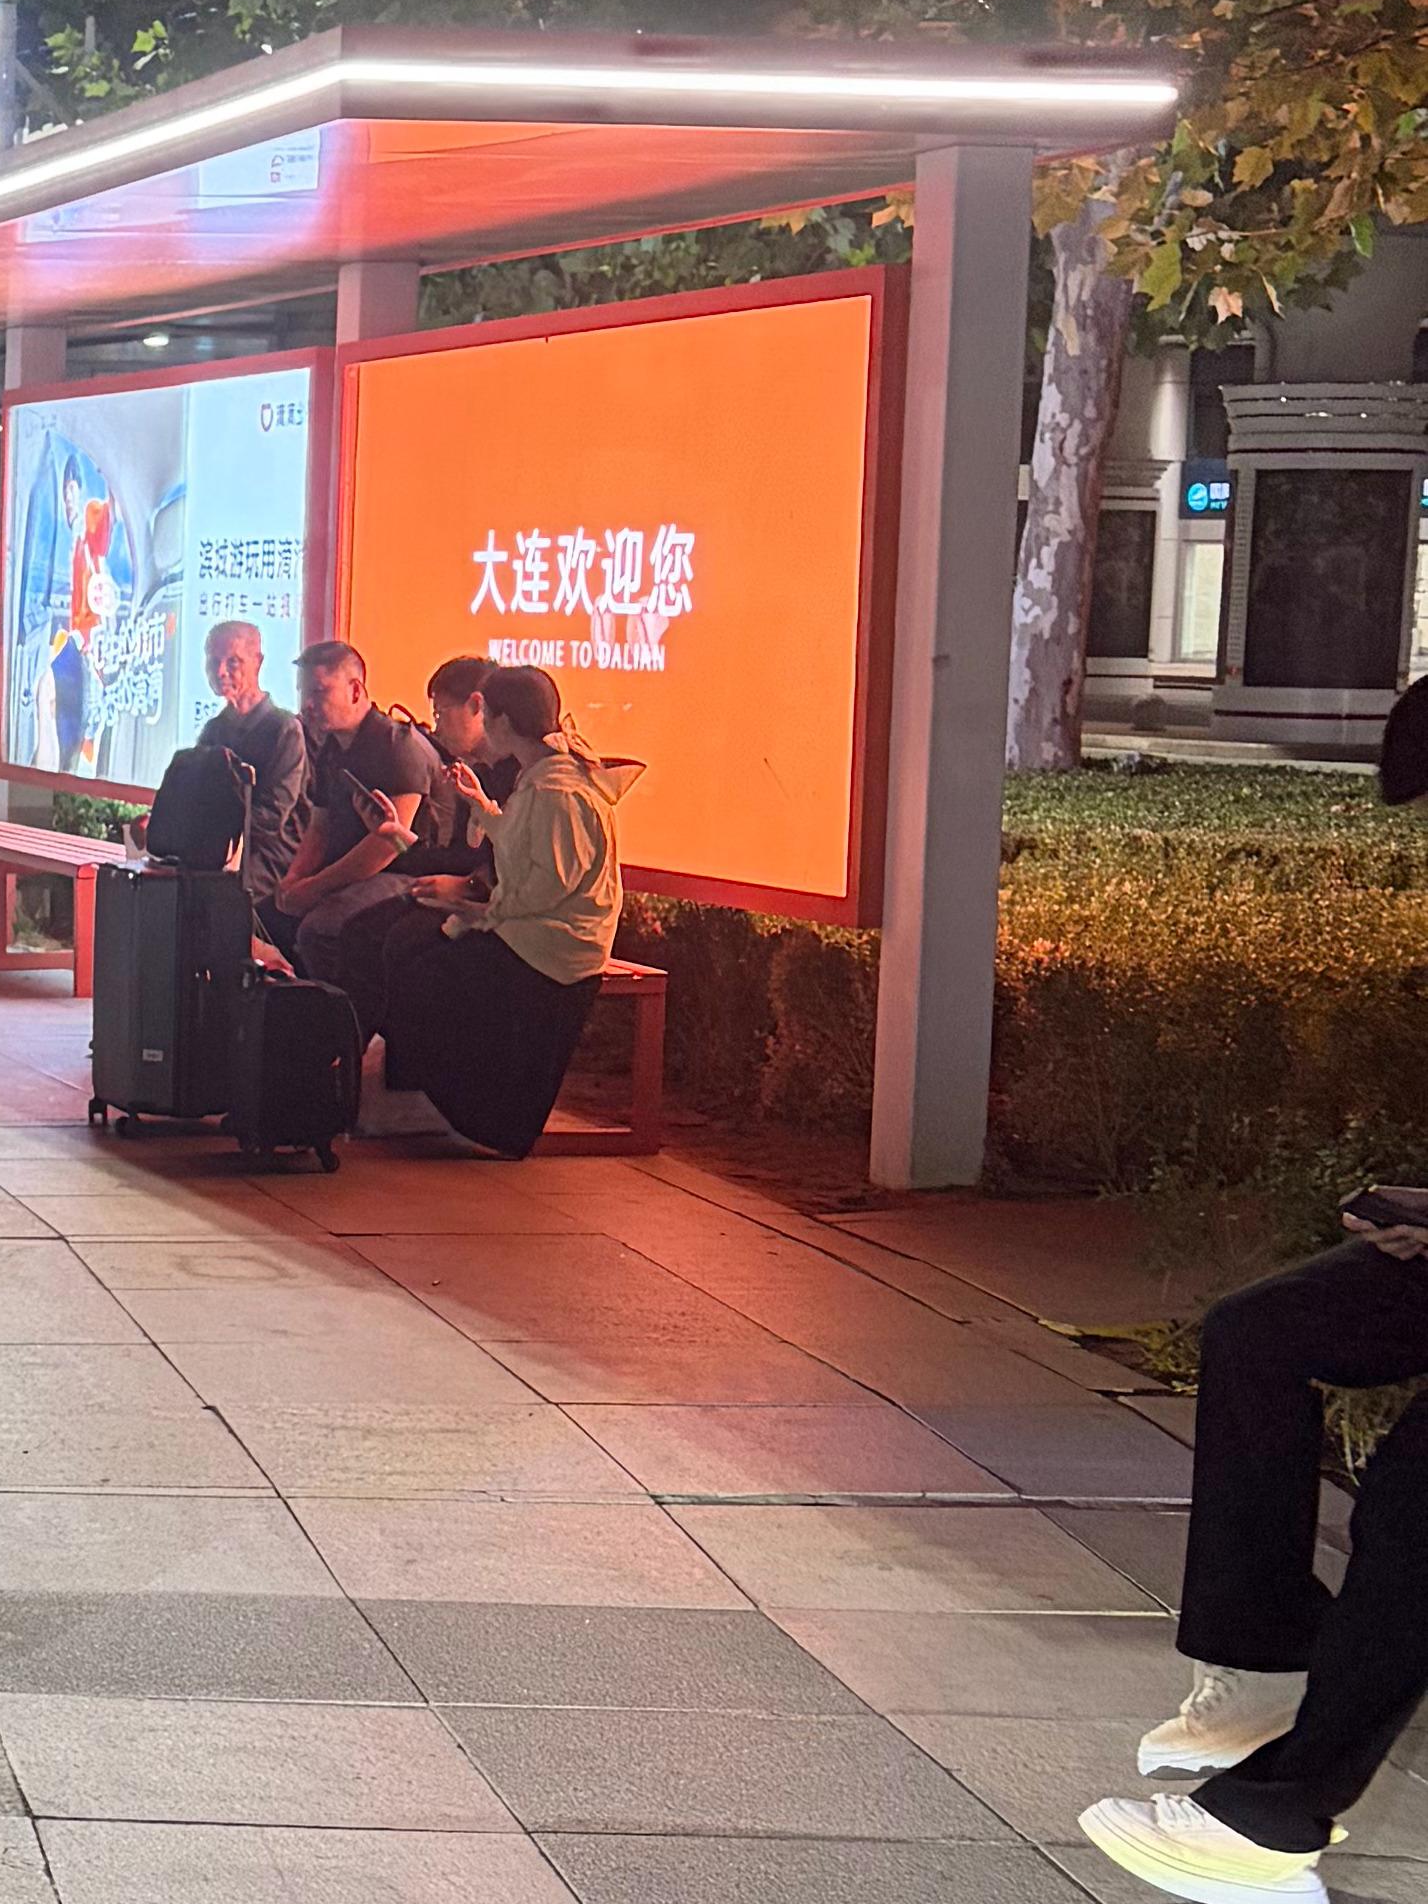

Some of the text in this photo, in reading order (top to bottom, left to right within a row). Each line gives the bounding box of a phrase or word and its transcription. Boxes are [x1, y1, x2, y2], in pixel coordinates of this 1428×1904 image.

[470, 523, 695, 617] 大连欢迎您
[488, 638, 666, 672] WELCOME TO DALIAN
